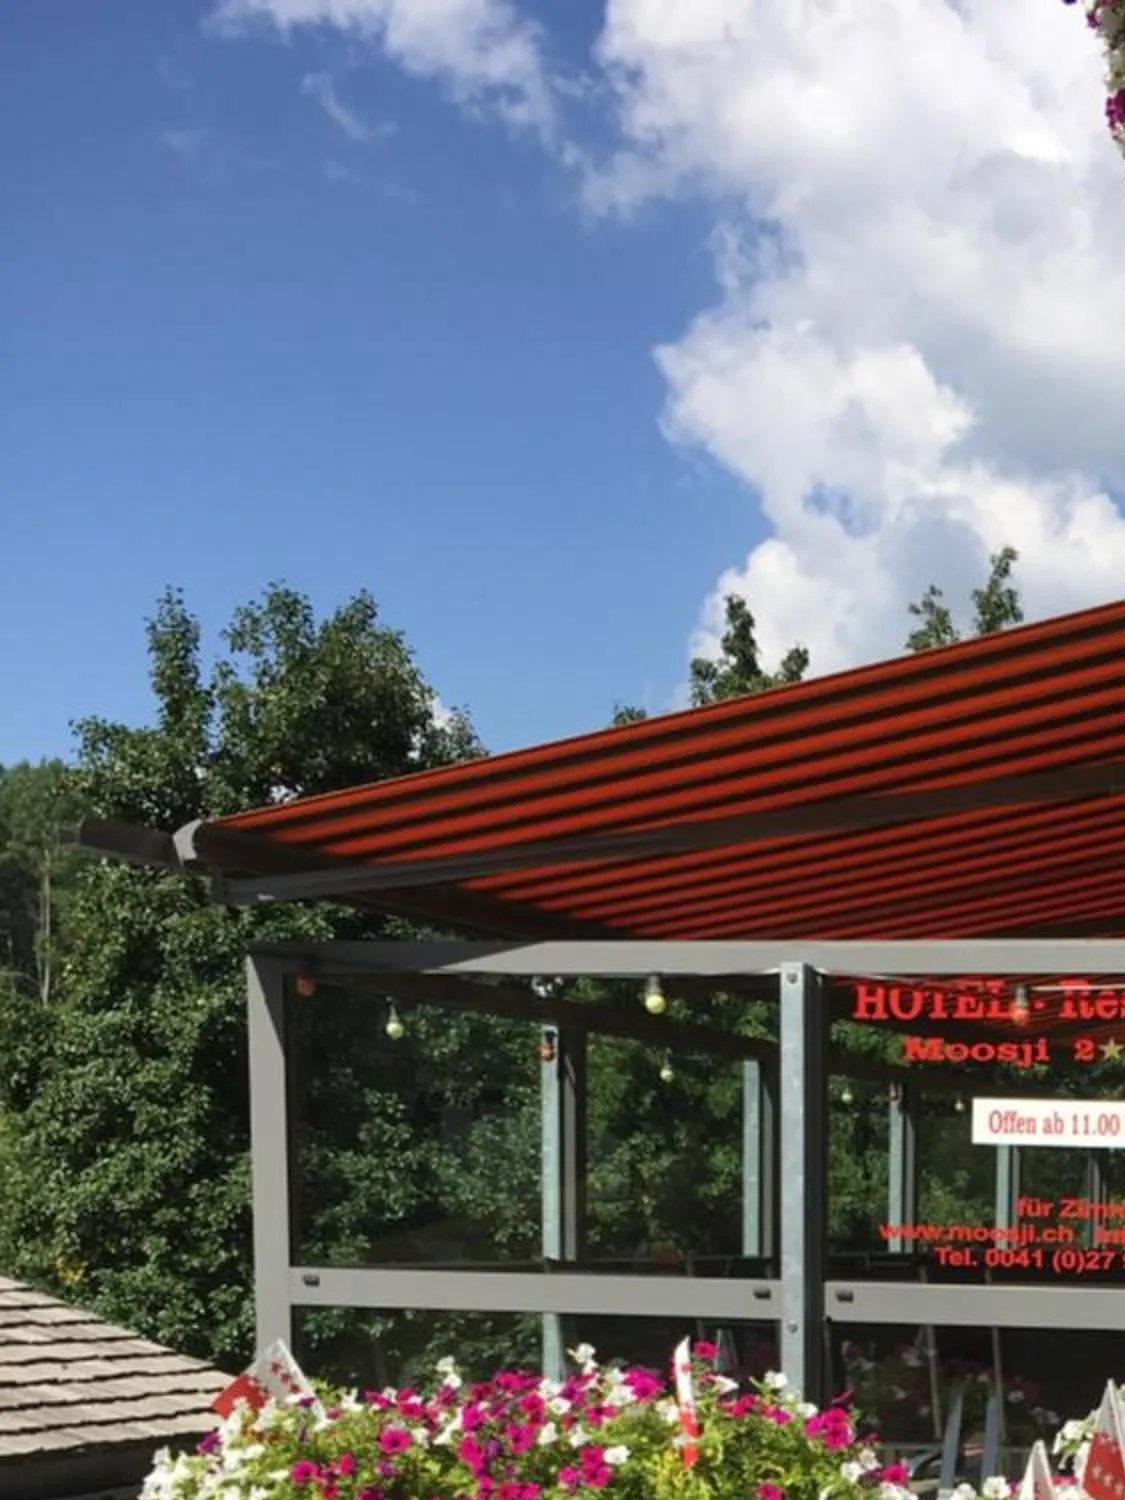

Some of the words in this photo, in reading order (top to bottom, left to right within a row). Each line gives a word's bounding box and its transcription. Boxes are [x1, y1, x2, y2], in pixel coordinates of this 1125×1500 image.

[854, 980, 1018, 1020] HOTEL
[904, 1036, 1049, 1068] Moosji
[989, 1110, 1037, 1135] Offen
[1042, 1111, 1065, 1135] ab
[1072, 1113, 1121, 1136] 11.00
[1016, 1197, 1053, 1217] für
[879, 1223, 1074, 1244] www.moosji.ch
[935, 1247, 977, 1267] Tel.
[984, 1247, 1043, 1268] 0041
